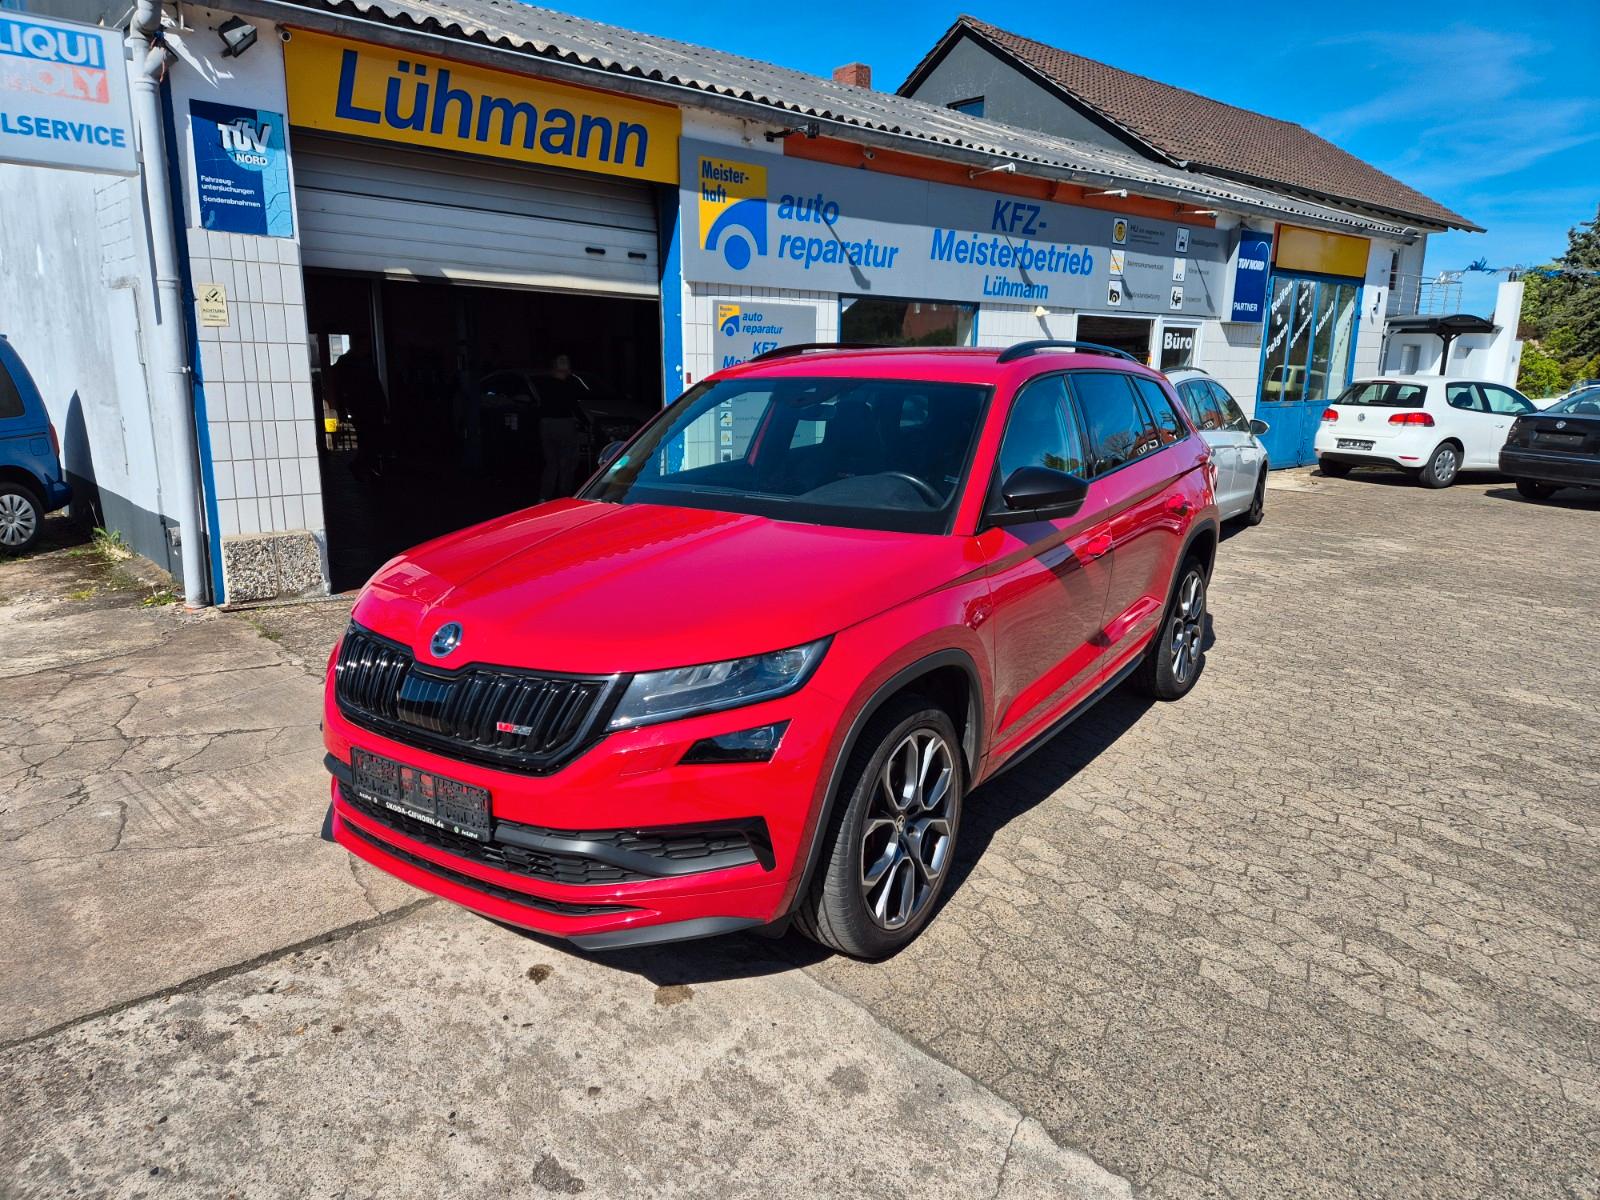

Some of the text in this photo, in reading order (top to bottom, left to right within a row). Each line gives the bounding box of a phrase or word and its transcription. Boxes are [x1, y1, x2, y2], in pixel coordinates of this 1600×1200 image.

[334, 48, 649, 167] Lühmann
[217, 120, 272, 154] TÜV
[236, 154, 268, 166] NORD
[702, 160, 750, 184] Meister-
[201, 175, 235, 186] Fahrzeug-
[201, 184, 255, 196] untersuchungen
[702, 181, 726, 203] haft
[203, 195, 261, 208] Sonderabnahmen
[777, 192, 840, 225] auto
[991, 200, 1047, 235] KFZ-
[778, 234, 899, 269] reparatur
[930, 228, 1094, 276] Meisterbetrieb
[983, 275, 1049, 299] Lühmann
[1271, 280, 1293, 314] Reifen
[742, 312, 763, 322] auto
[1233, 302, 1258, 311] PARTNER
[742, 325, 784, 335] reparatur
[1163, 332, 1193, 350] Büro
[1266, 322, 1288, 359] Felgen
